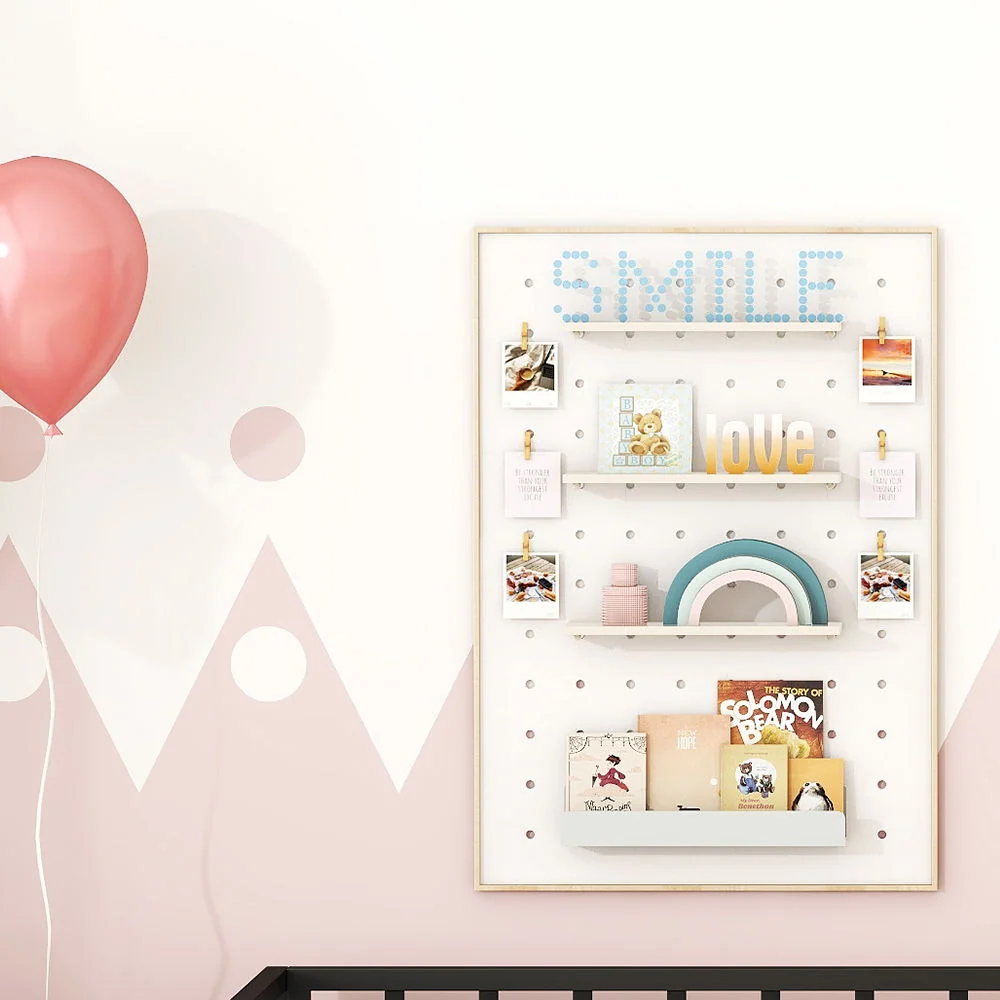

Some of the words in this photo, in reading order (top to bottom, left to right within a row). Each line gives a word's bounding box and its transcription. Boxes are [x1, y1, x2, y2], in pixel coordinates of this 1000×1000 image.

[553, 249, 844, 322] SMILE
[705, 413, 815, 475] love
[720, 690, 824, 730] SOLOMON
[764, 686, 780, 694] THE
[781, 687, 809, 696] STORY
[811, 689, 823, 697] OF
[738, 711, 796, 745] BEAR
